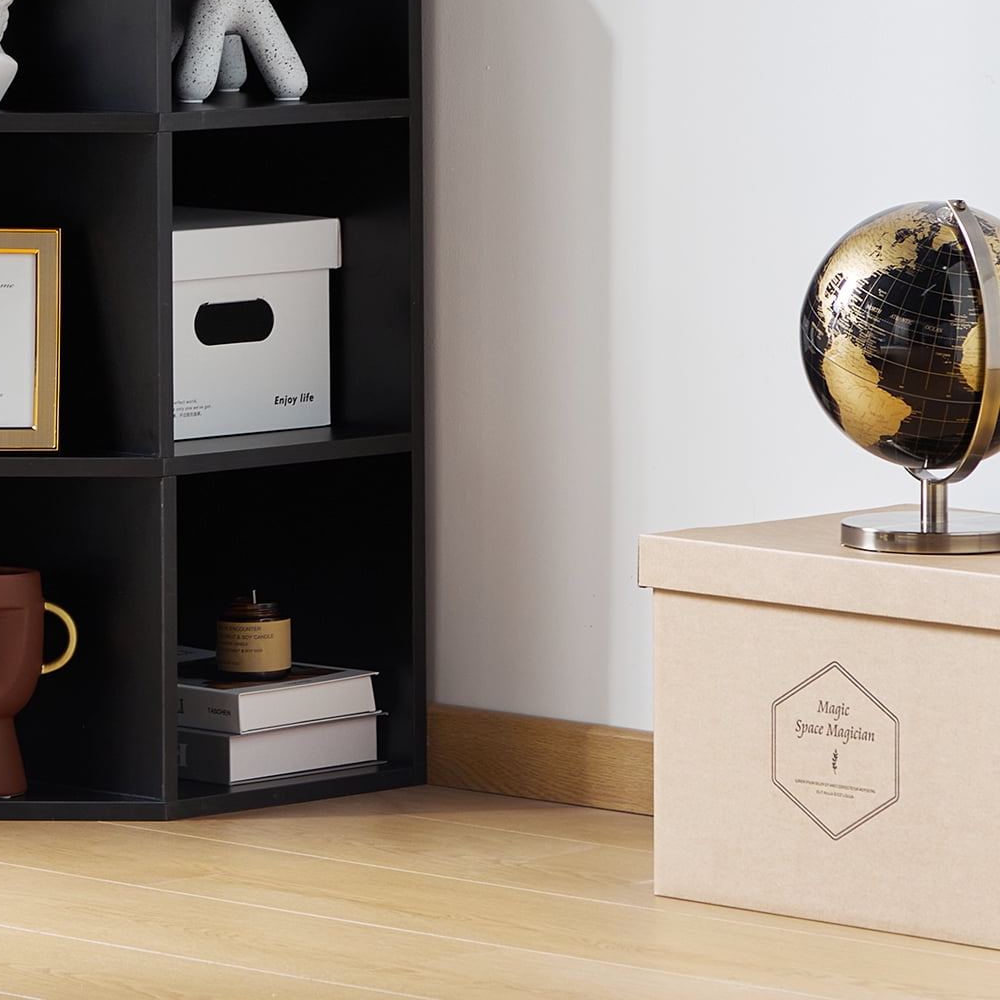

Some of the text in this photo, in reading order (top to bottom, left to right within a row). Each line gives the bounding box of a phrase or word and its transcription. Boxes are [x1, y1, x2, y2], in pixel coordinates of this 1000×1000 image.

[274, 392, 314, 407] Enjoy life
[817, 699, 850, 721] Magic
[795, 719, 875, 745] Space Magician
